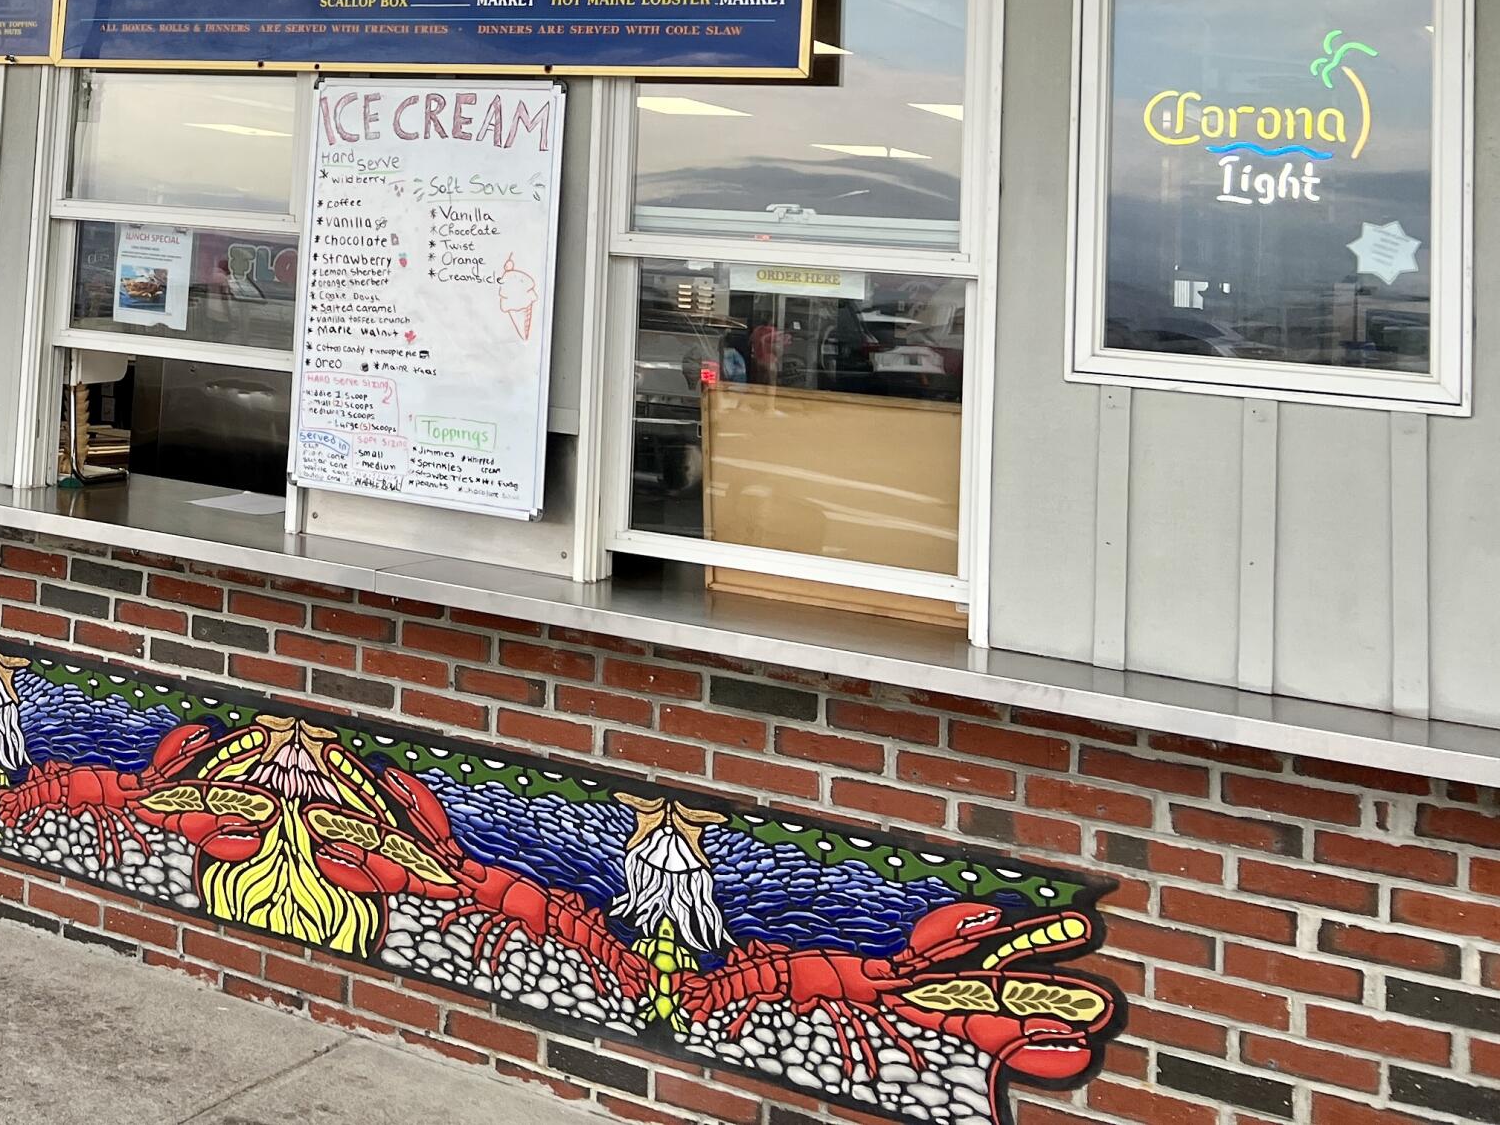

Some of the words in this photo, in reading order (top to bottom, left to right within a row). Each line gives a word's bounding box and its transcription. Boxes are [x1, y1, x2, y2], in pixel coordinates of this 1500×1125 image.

[478, 25, 532, 34] DINNERS
[538, 26, 564, 34] ARE
[570, 26, 620, 34] SERVED
[626, 26, 661, 35] WITH
[666, 27, 700, 35] COLE
[705, 27, 742, 35] SLAW
[320, 92, 381, 145] ICE
[393, 93, 549, 151] CREAM
[1144, 90, 1347, 145] Corona
[1216, 155, 1321, 205] Light
[439, 206, 495, 222] Vanilla
[125, 231, 150, 242] LUNCH
[151, 233, 180, 244] SPECIAL
[438, 225, 500, 237] Chocolate
[441, 239, 475, 251] Twist
[441, 252, 486, 273] Orange
[756, 269, 801, 282] ORDER
[805, 272, 840, 285] HERE
[421, 420, 489, 450] Toppings
